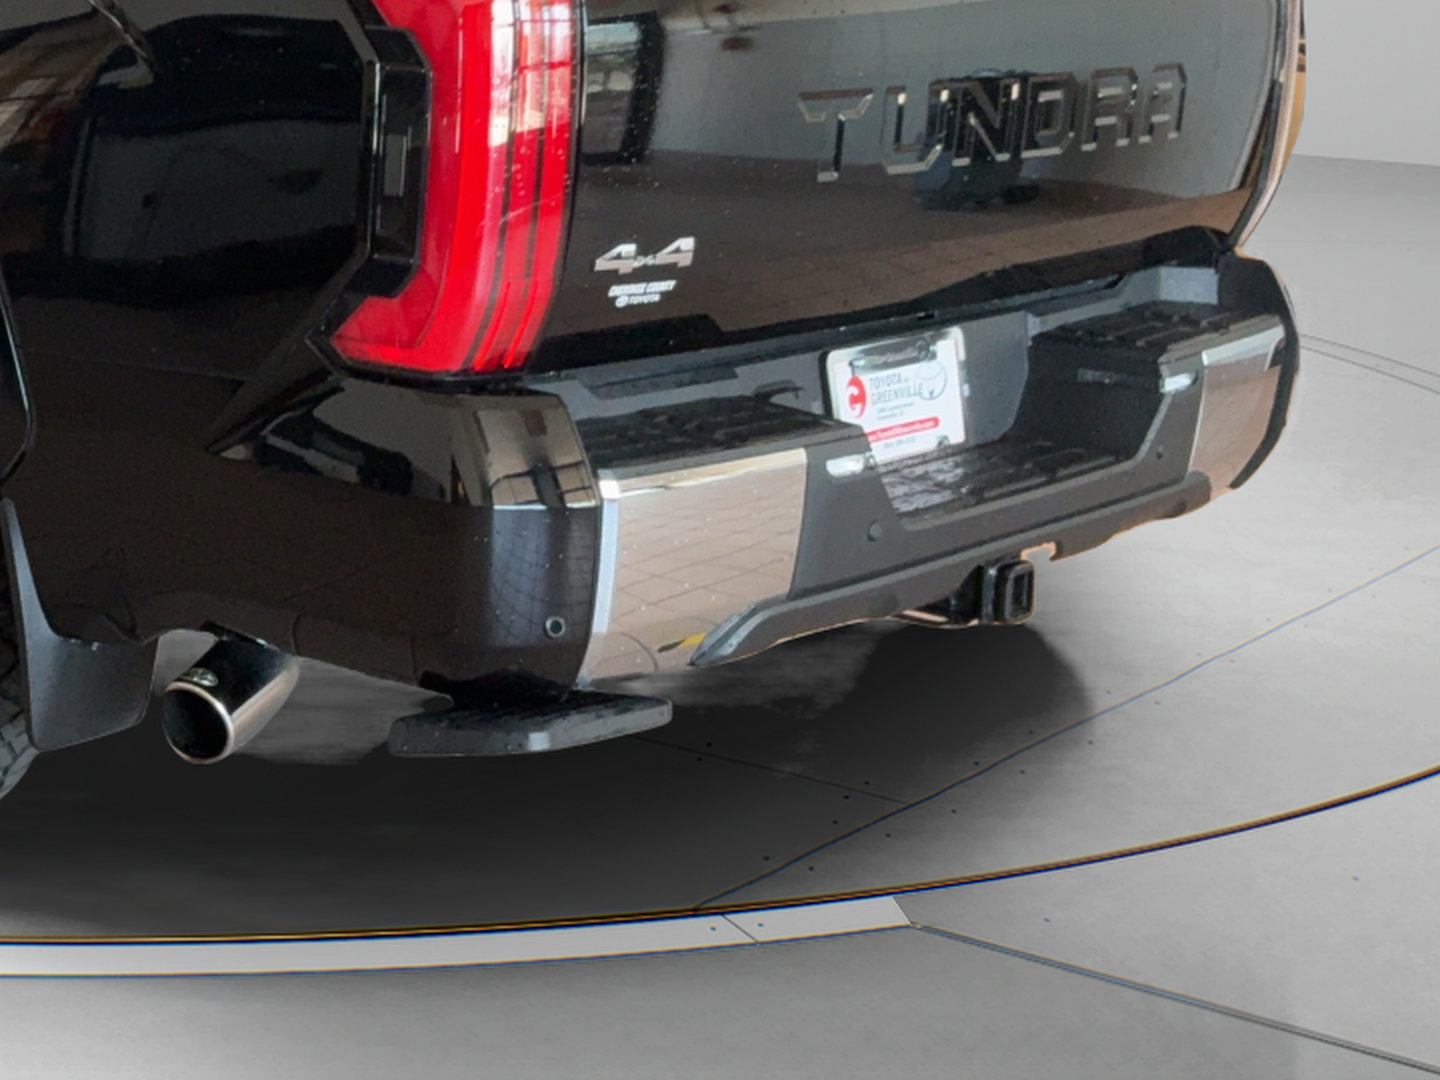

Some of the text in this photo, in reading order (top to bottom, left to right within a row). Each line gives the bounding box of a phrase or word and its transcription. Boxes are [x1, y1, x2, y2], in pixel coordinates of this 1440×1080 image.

[797, 62, 1188, 183] TUNDRA
[593, 236, 695, 275] 4x4
[868, 372, 902, 389] TOYOTA
[870, 383, 924, 407] GREENVILLE
